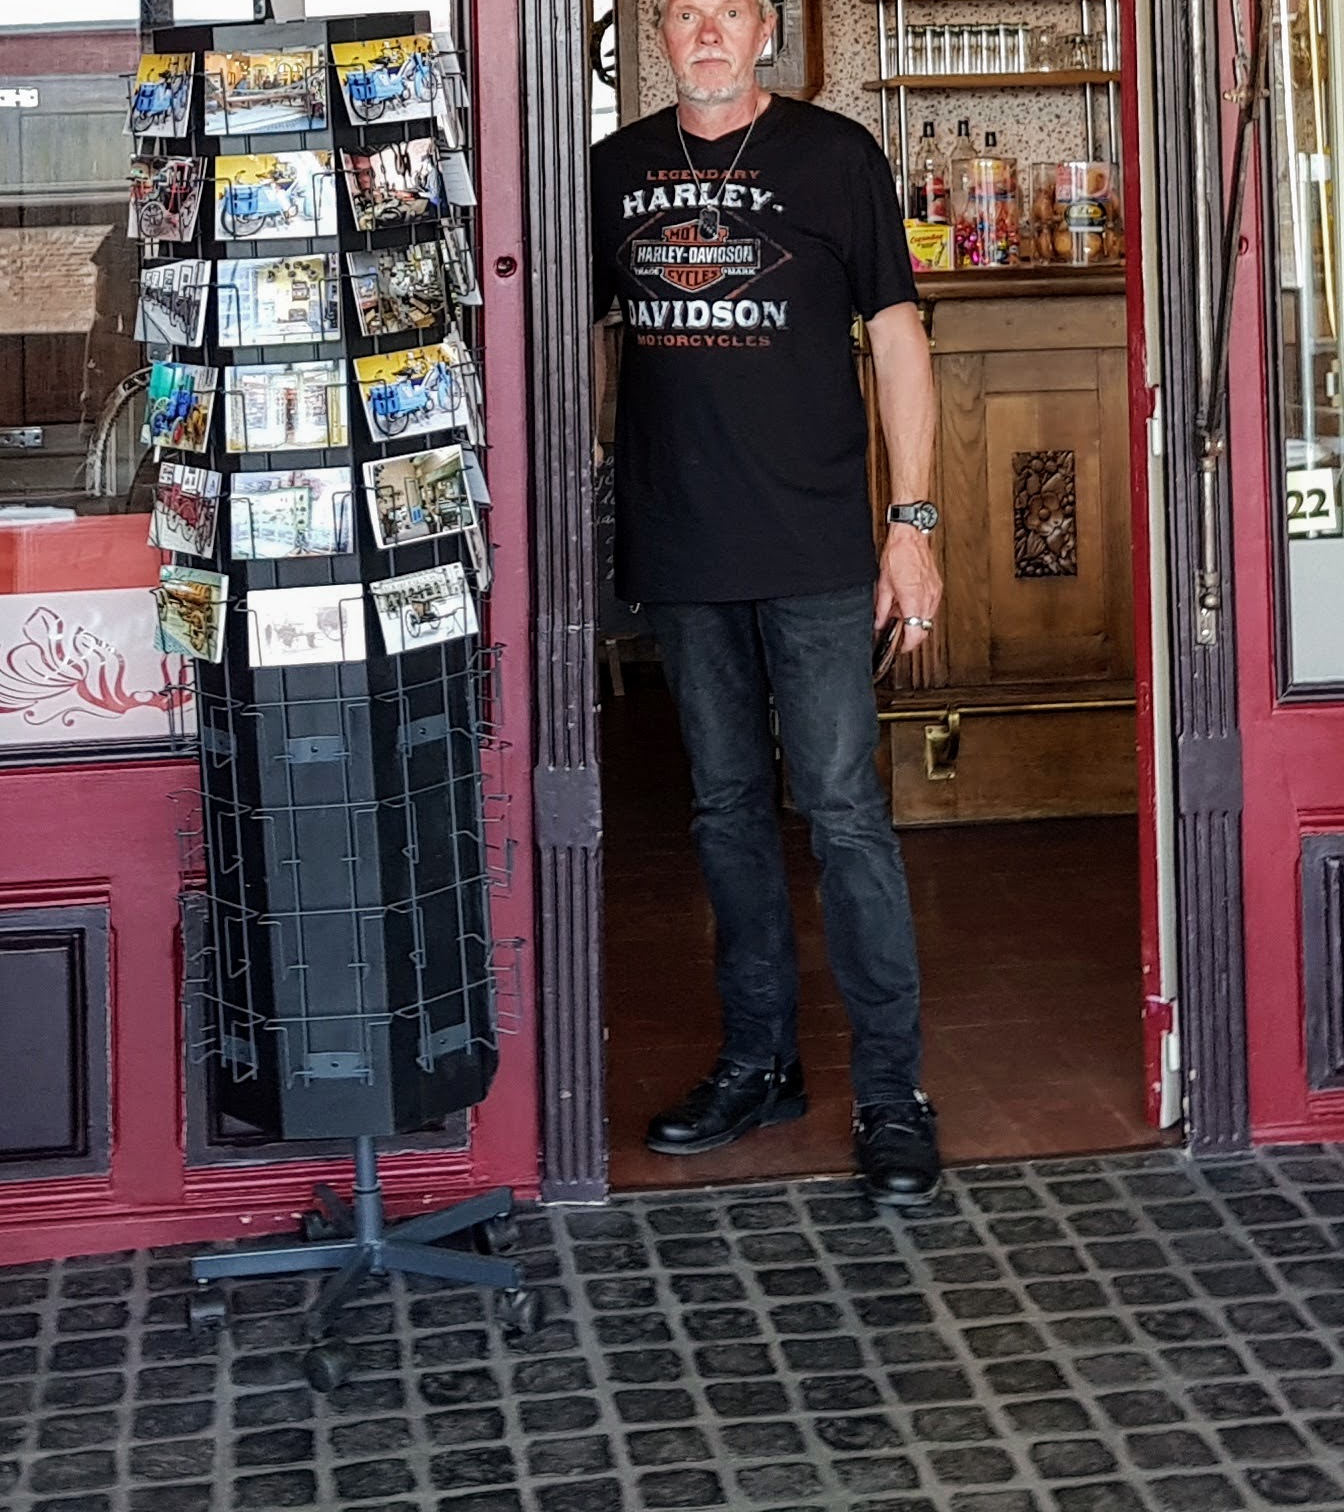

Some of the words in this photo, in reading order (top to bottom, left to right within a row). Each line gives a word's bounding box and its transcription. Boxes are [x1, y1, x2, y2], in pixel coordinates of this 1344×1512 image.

[646, 169, 761, 181] LEGENDARY
[637, 245, 754, 264] HARLEY-DAVIDSON
[667, 268, 719, 287] CYCLES
[628, 299, 789, 330] DAVIDSON
[637, 334, 772, 348] MOTORCYCLES
[1287, 487, 1330, 519] 22
